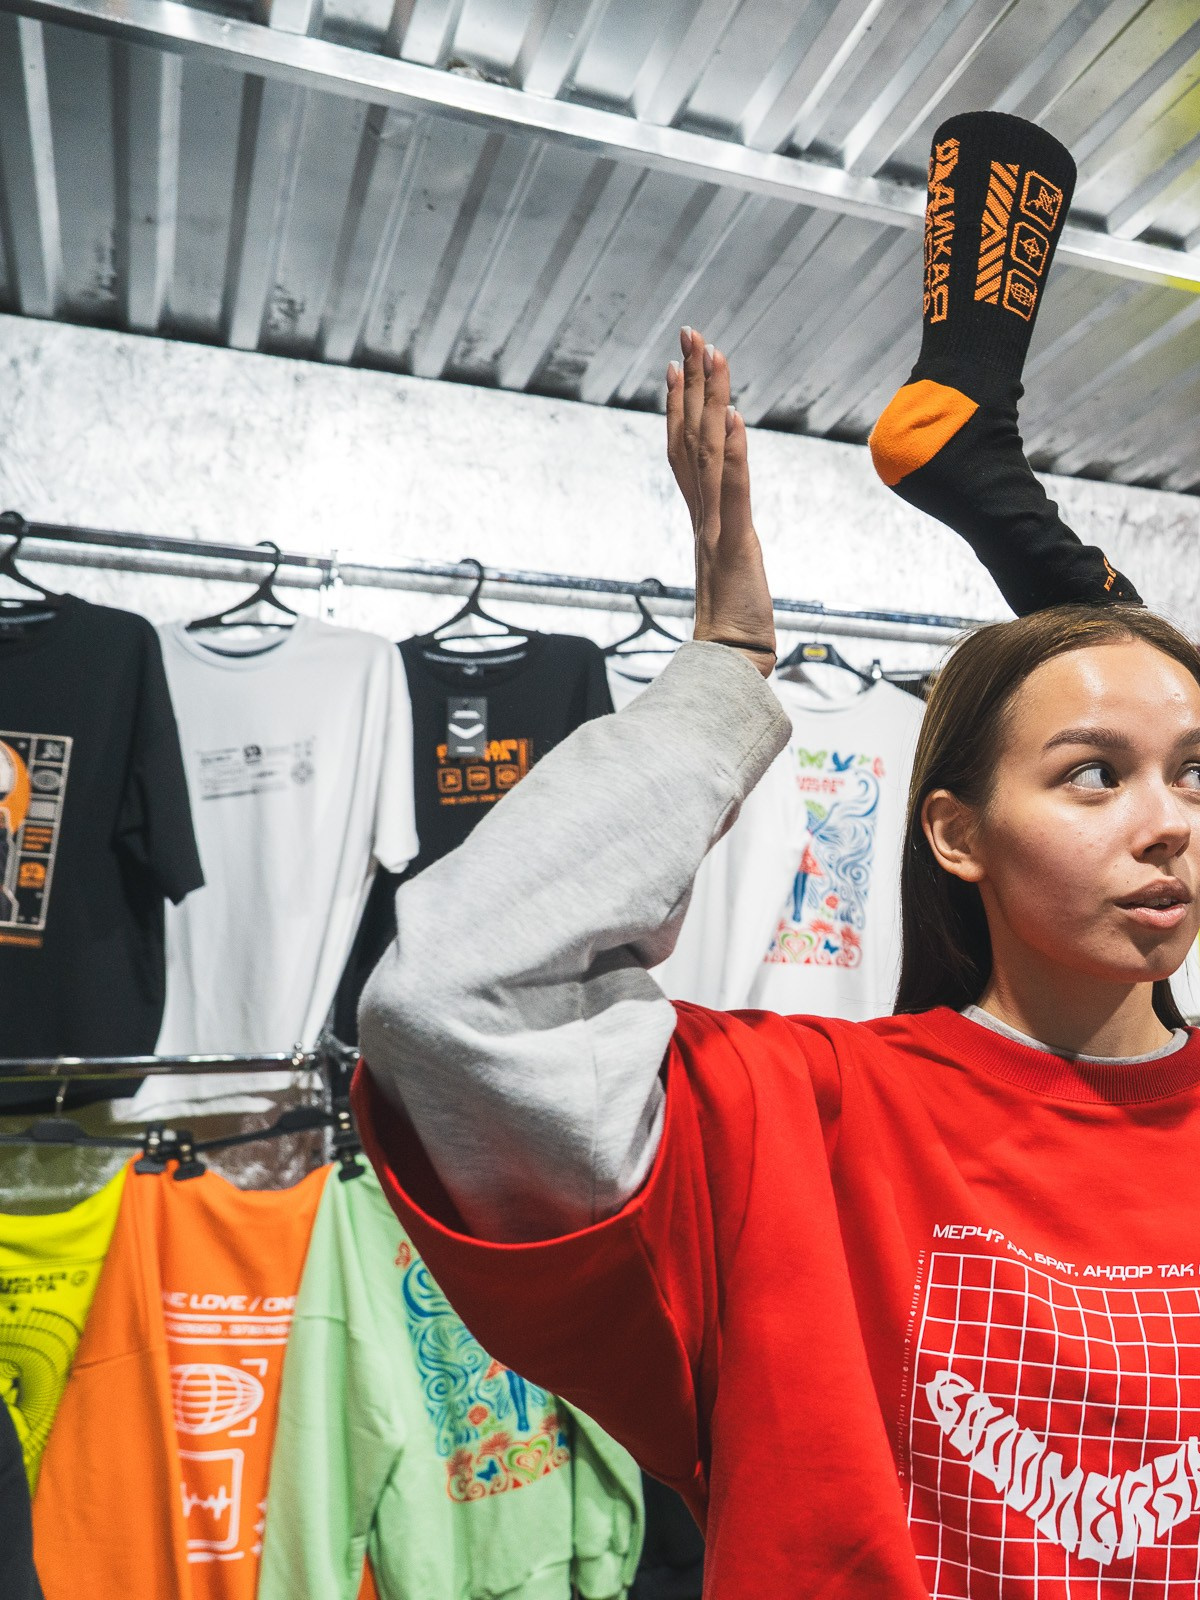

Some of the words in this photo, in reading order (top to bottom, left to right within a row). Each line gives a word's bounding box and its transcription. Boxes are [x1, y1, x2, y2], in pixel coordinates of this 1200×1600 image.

[932, 1223, 1005, 1243] МЕРЧ?
[1034, 1252, 1079, 1277] БРАТ,
[1082, 1264, 1153, 1281] АНДОР
[1157, 1263, 1194, 1278] ТАК
[189, 1293, 248, 1311] LOVE
